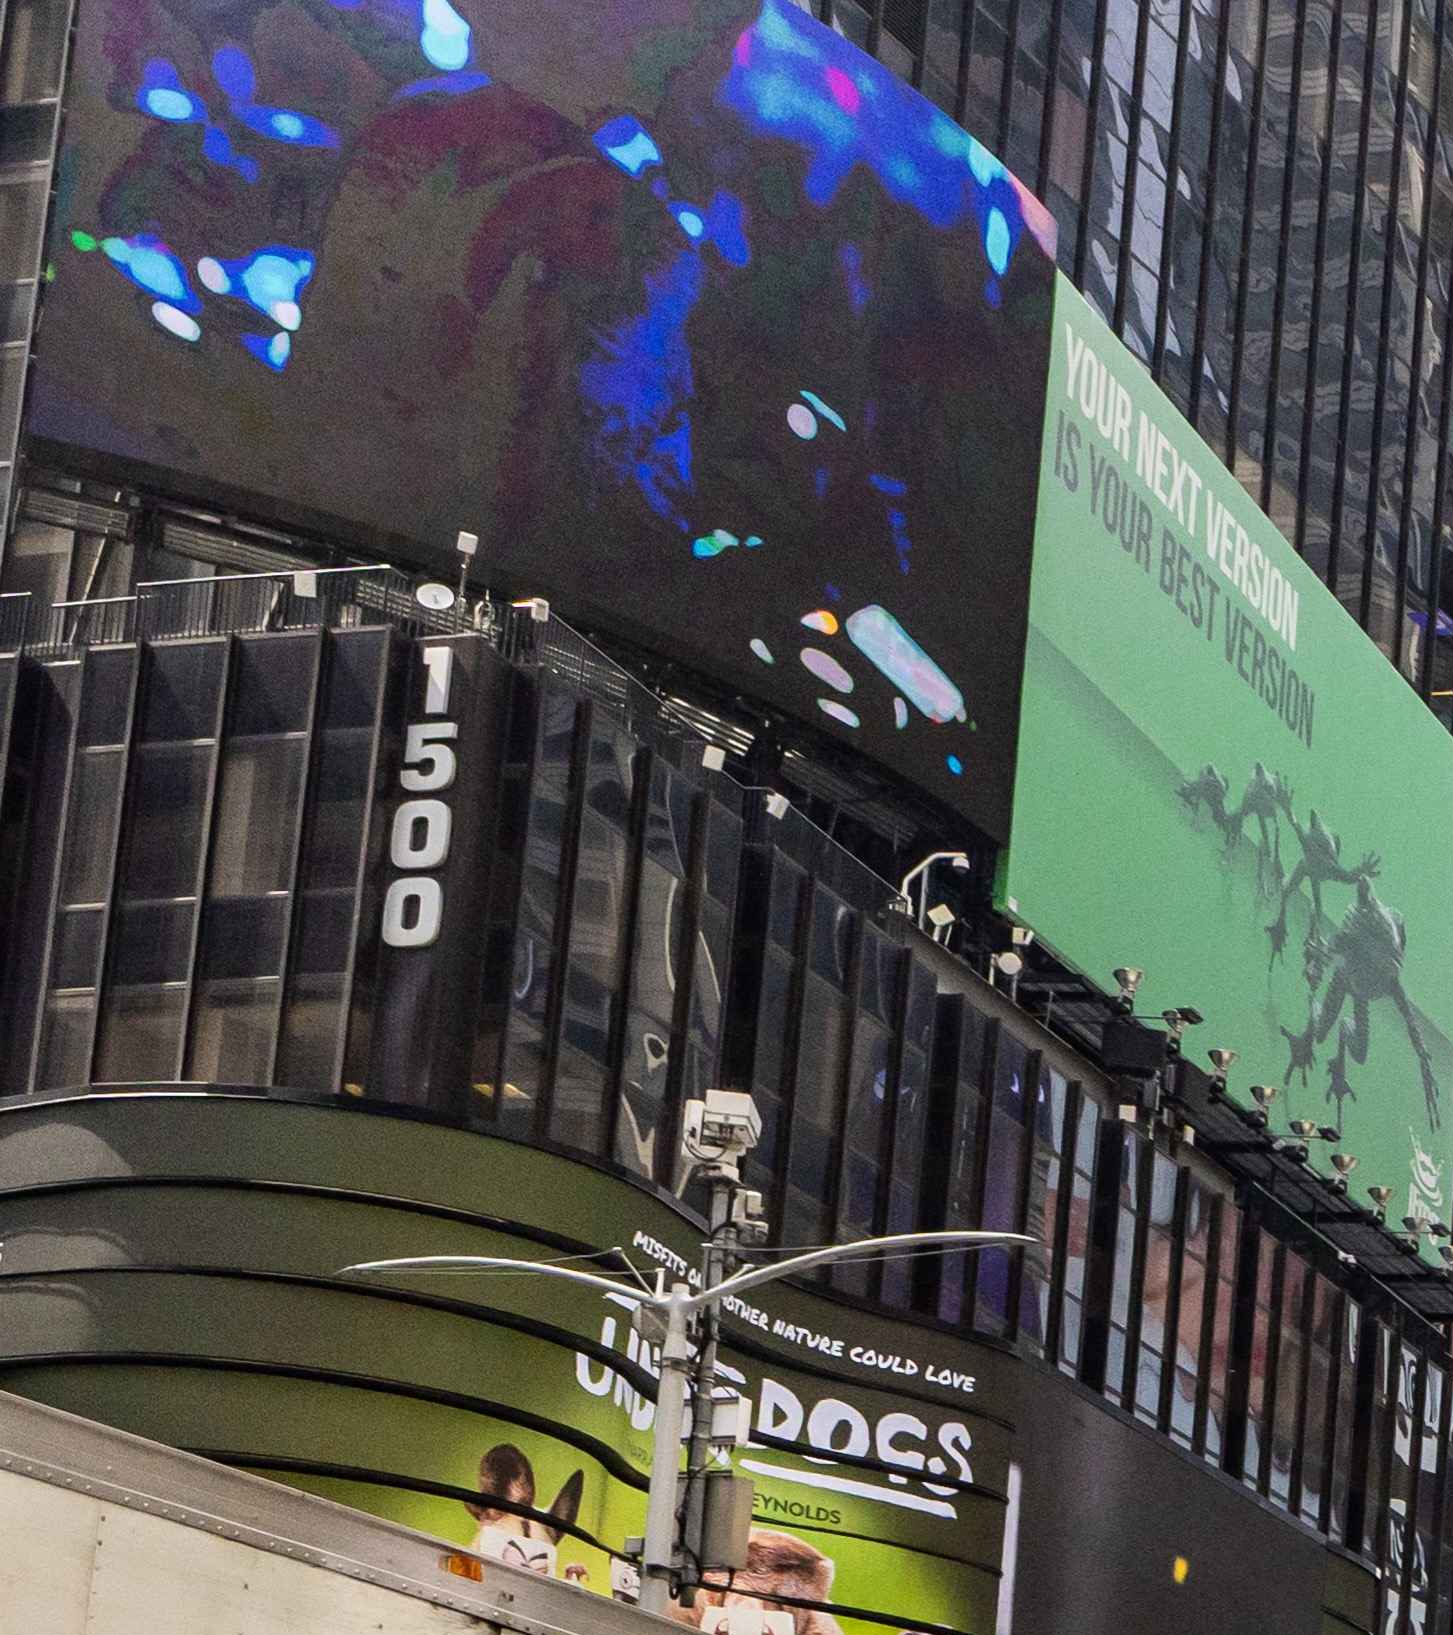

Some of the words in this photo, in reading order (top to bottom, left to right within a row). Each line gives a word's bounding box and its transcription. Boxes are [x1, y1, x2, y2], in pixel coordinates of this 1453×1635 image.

[1053, 408, 1082, 494] IS
[1088, 443, 1154, 576] YOUR
[1158, 525, 1221, 642] BEST
[1223, 594, 1316, 750] VERSION
[1063, 322, 1132, 463] YOUR
[1136, 408, 1203, 538] NEXT
[1204, 488, 1299, 651] VERSION
[381, 645, 459, 948] 1500
[632, 1230, 690, 1277] MISFITS
[721, 1294, 769, 1332] OTHER
[771, 1318, 846, 1359] NATURE
[849, 1342, 920, 1378] COULD
[925, 1363, 977, 1393] LOVE
[751, 1491, 842, 1525] EYNOLDS
